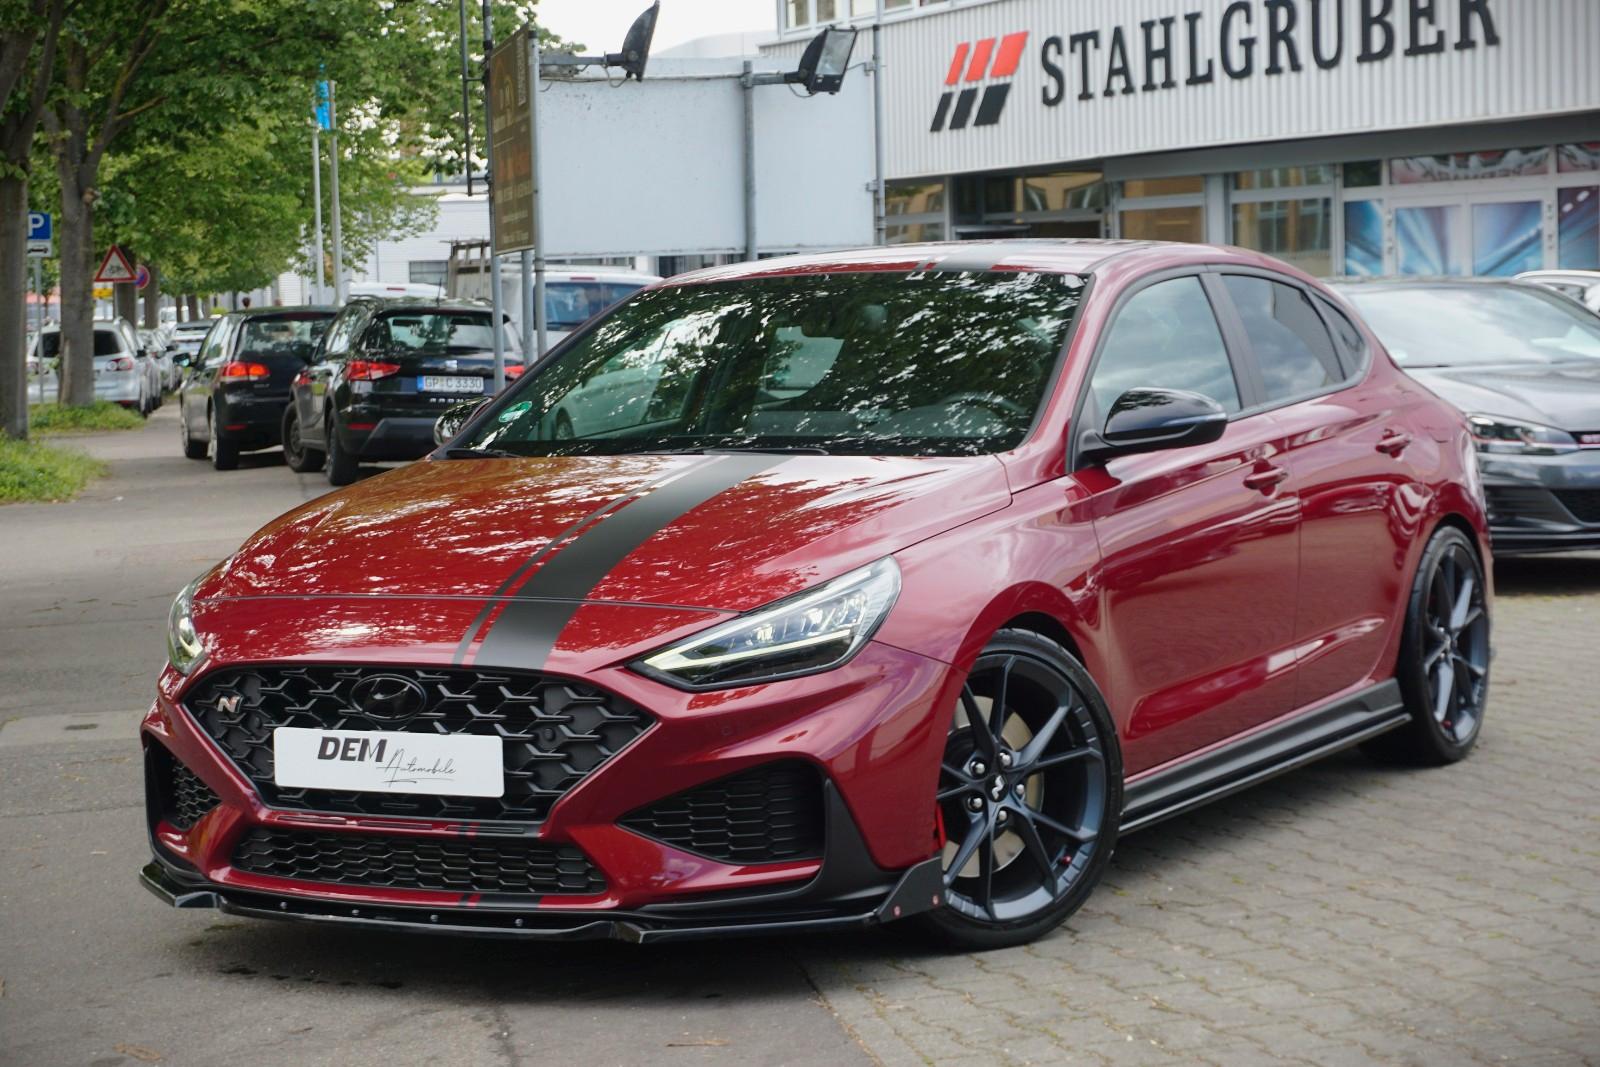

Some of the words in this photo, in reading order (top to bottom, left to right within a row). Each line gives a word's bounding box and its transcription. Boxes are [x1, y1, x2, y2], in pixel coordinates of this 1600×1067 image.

[1041, 0, 1500, 107] STAHLGRUBER
[28, 213, 45, 237] P
[217, 696, 240, 713] N
[317, 736, 388, 762] DEM
